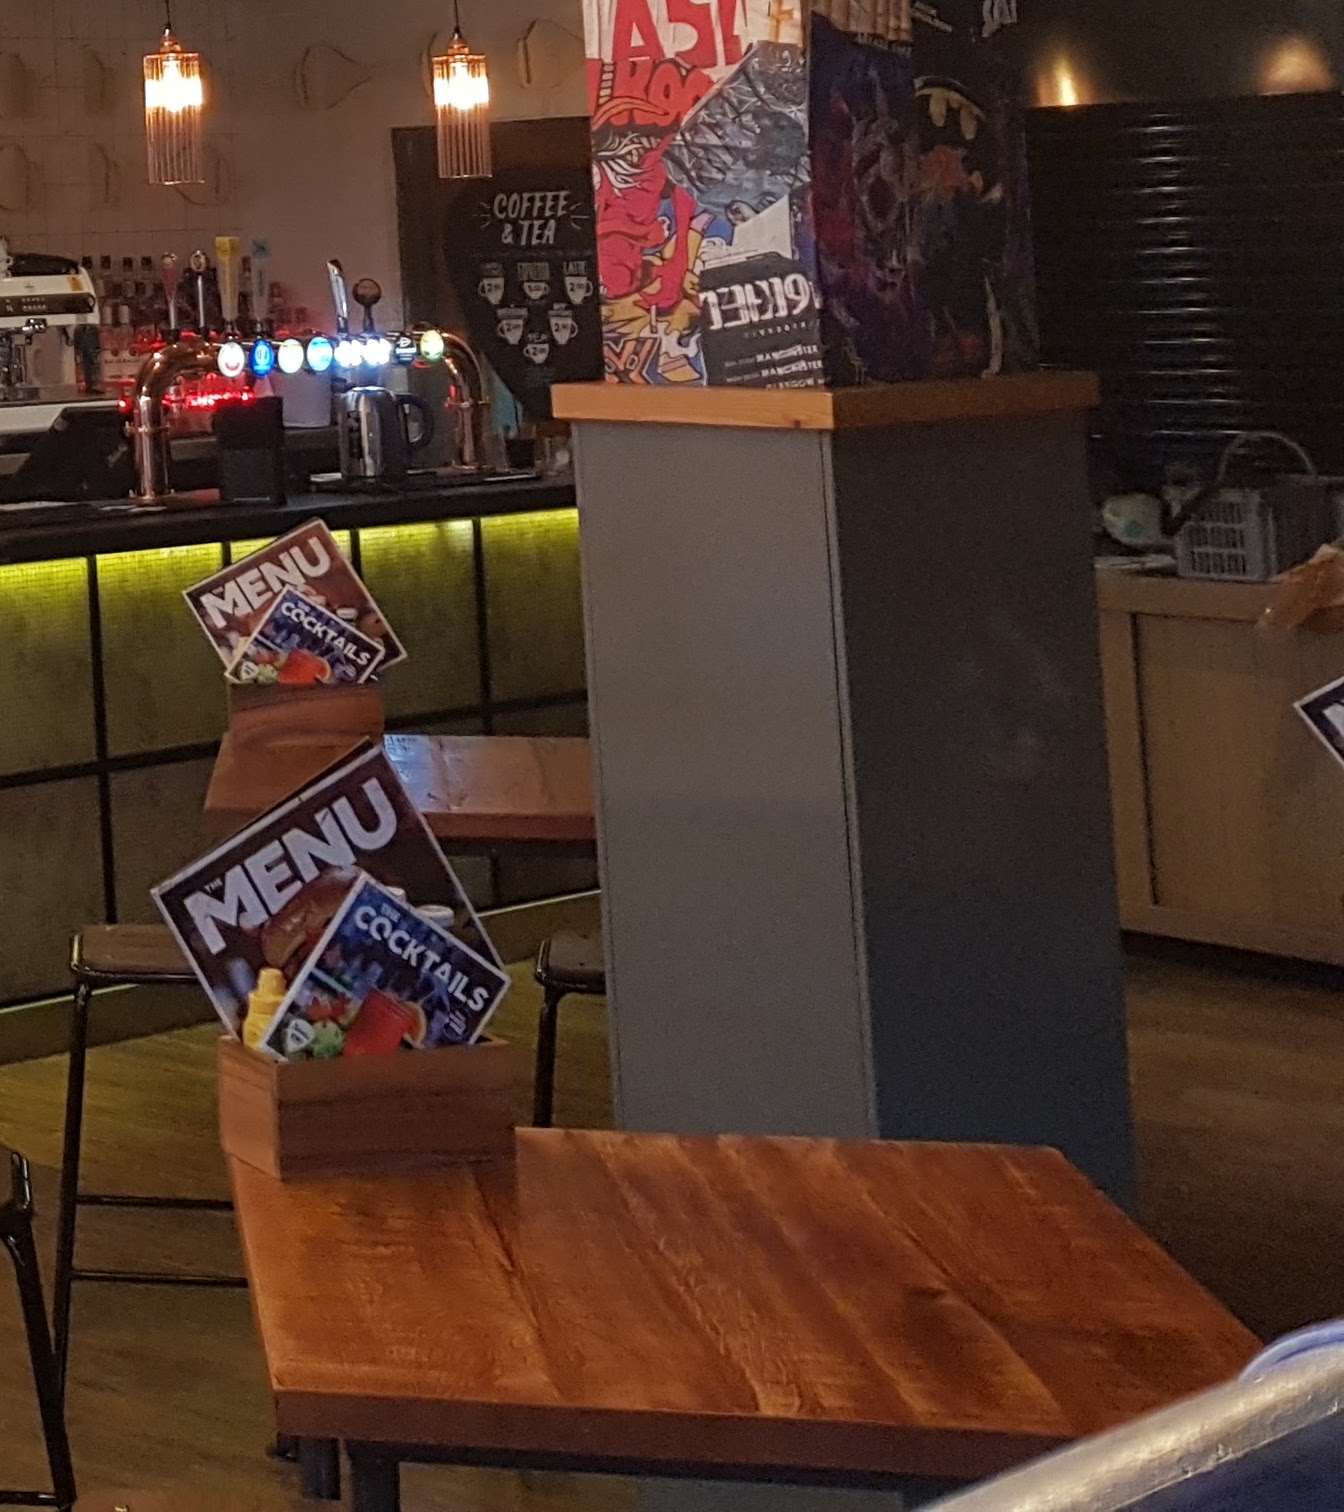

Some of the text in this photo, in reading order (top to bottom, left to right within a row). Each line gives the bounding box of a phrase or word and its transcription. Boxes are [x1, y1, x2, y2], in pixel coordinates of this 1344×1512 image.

[493, 190, 570, 219] COFFEE
[501, 219, 556, 246] & TEA
[199, 536, 331, 629] MENU
[281, 601, 372, 666] COCKTAILS
[183, 776, 398, 956] MENU
[354, 905, 490, 1012] COCKTAILS
